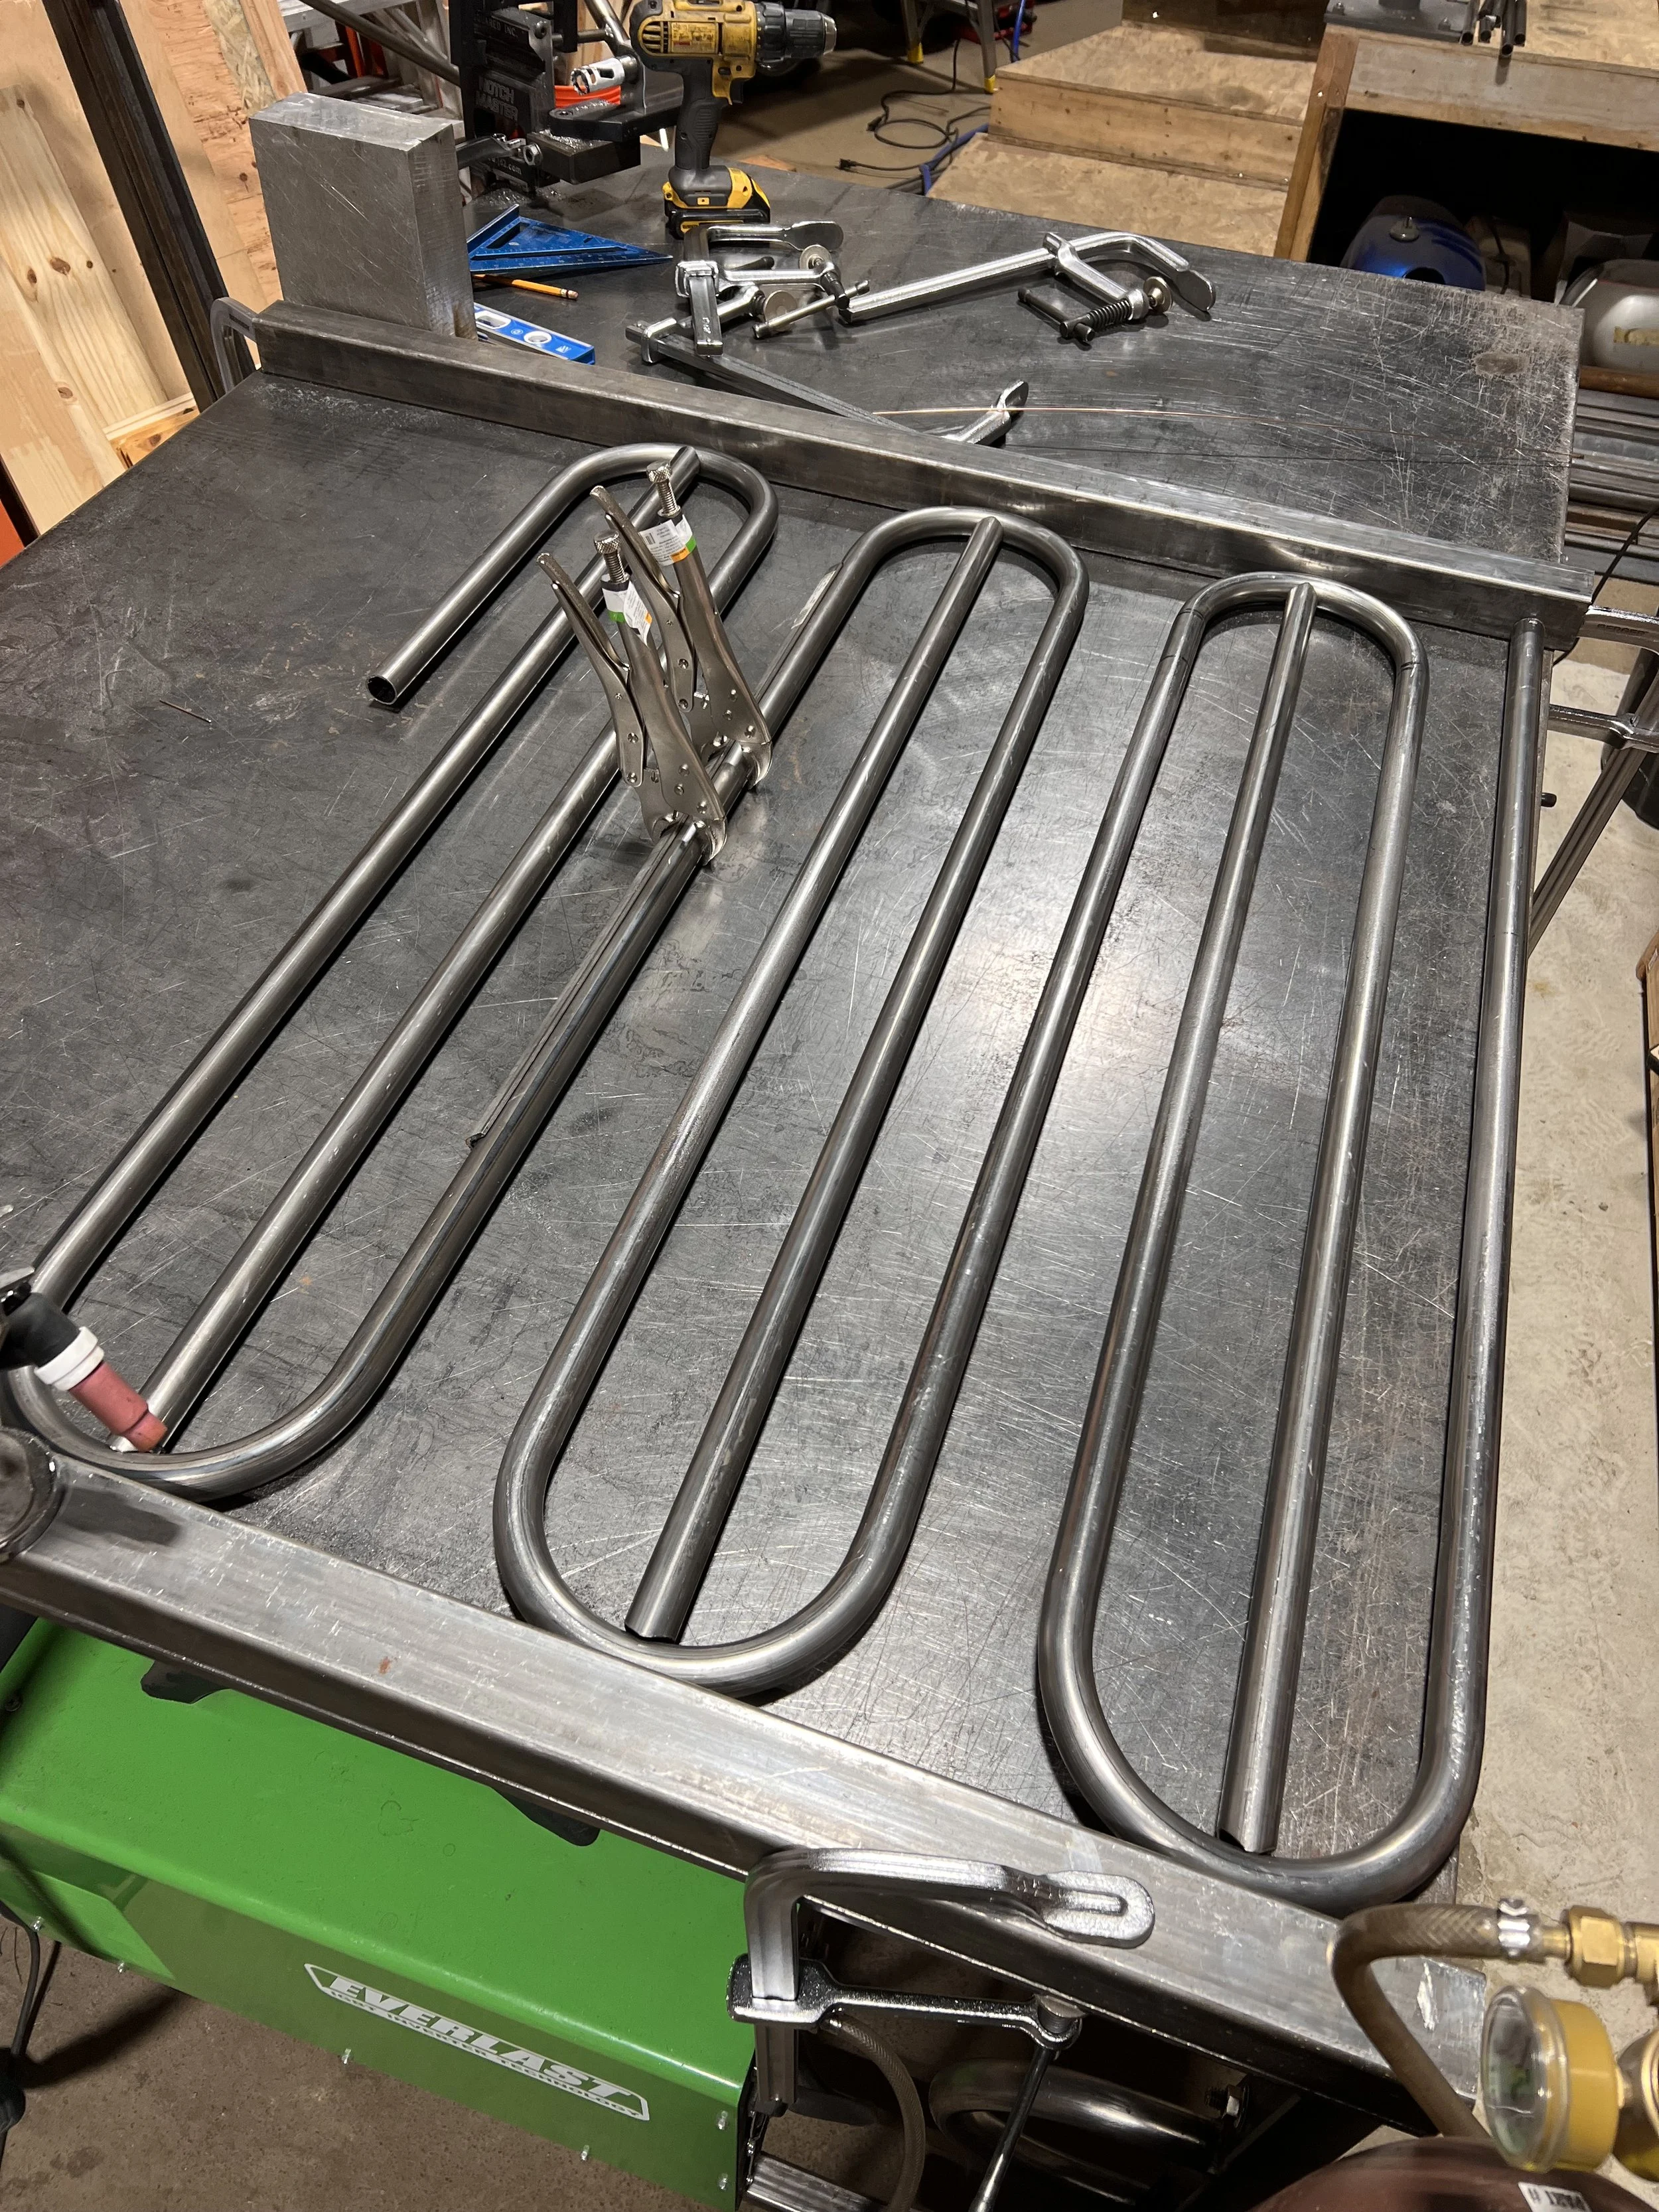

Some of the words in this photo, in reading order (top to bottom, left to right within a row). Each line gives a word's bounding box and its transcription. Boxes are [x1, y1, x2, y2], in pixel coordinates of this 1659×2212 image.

[475, 90, 518, 121] MASTER
[478, 75, 515, 104] NOTCH
[329, 1976, 632, 2098] EVERLAST
[387, 2013, 488, 2057] INVERTER
[500, 2059, 639, 2116] TECHNOLOGY
